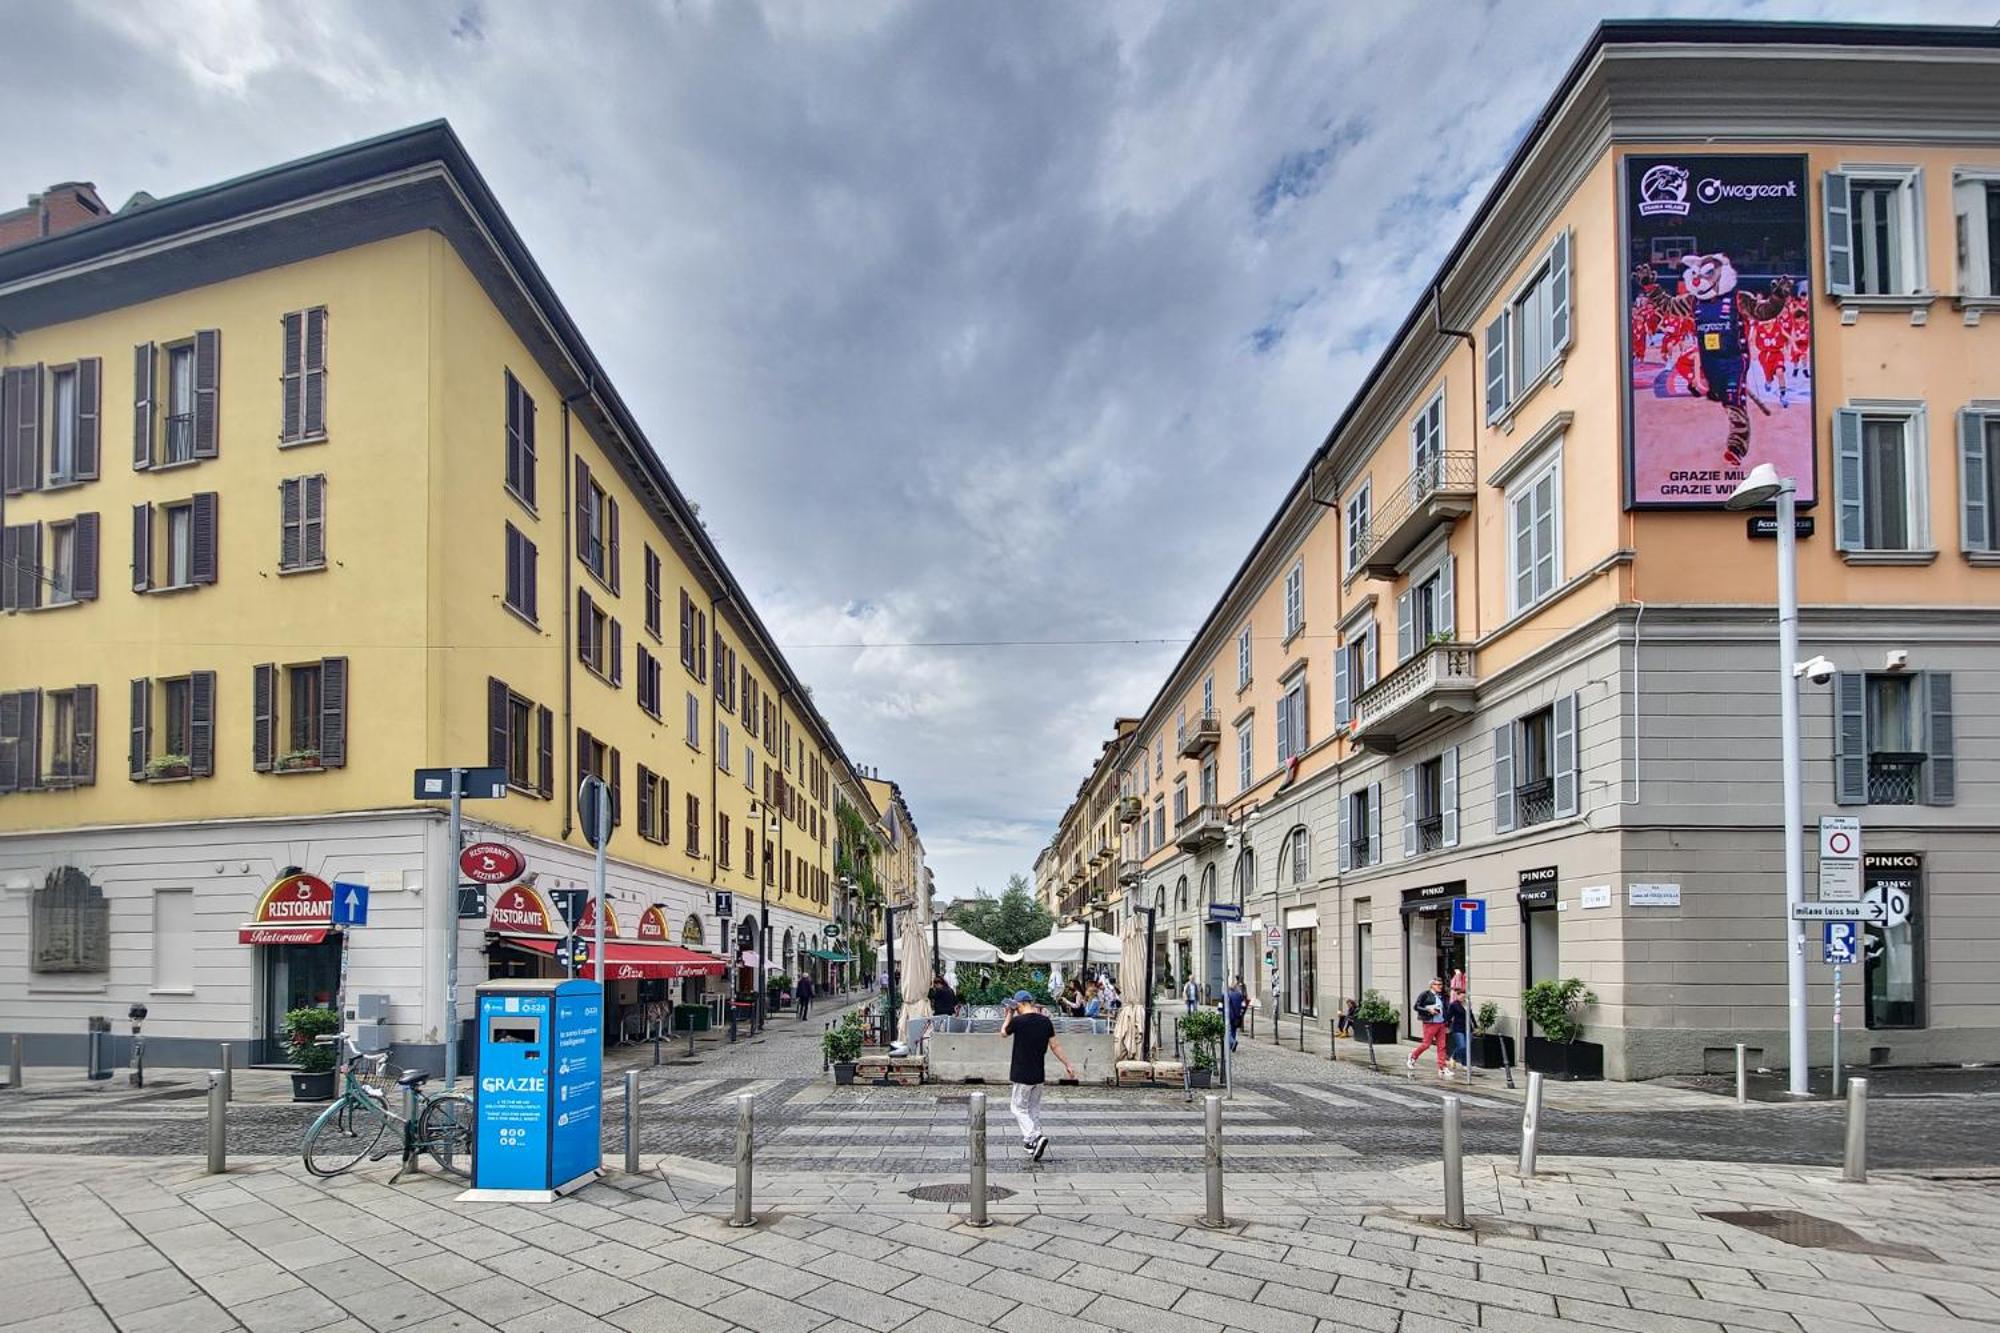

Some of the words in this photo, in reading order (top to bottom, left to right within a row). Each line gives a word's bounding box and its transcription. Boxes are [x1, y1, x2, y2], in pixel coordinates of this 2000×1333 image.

[1721, 180, 1797, 200] wegreenit
[1669, 471, 1721, 481] GRAZIE
[1724, 471, 1748, 481] MIL
[1660, 485, 1712, 495] GRAZIE
[469, 846, 511, 859] RISTORANTE
[1865, 856, 1913, 867] PINKO
[1521, 869, 1555, 882] PINKO
[1421, 886, 1445, 896] PINKO
[1521, 891, 1548, 900] PINKO
[268, 900, 332, 917] RISTORANT
[1796, 907, 1822, 915] milano
[1846, 907, 1860, 915] hub
[494, 908, 543, 925] RISTORANTE
[250, 929, 313, 943] Ristorante
[482, 1076, 545, 1093] GRAZIE
